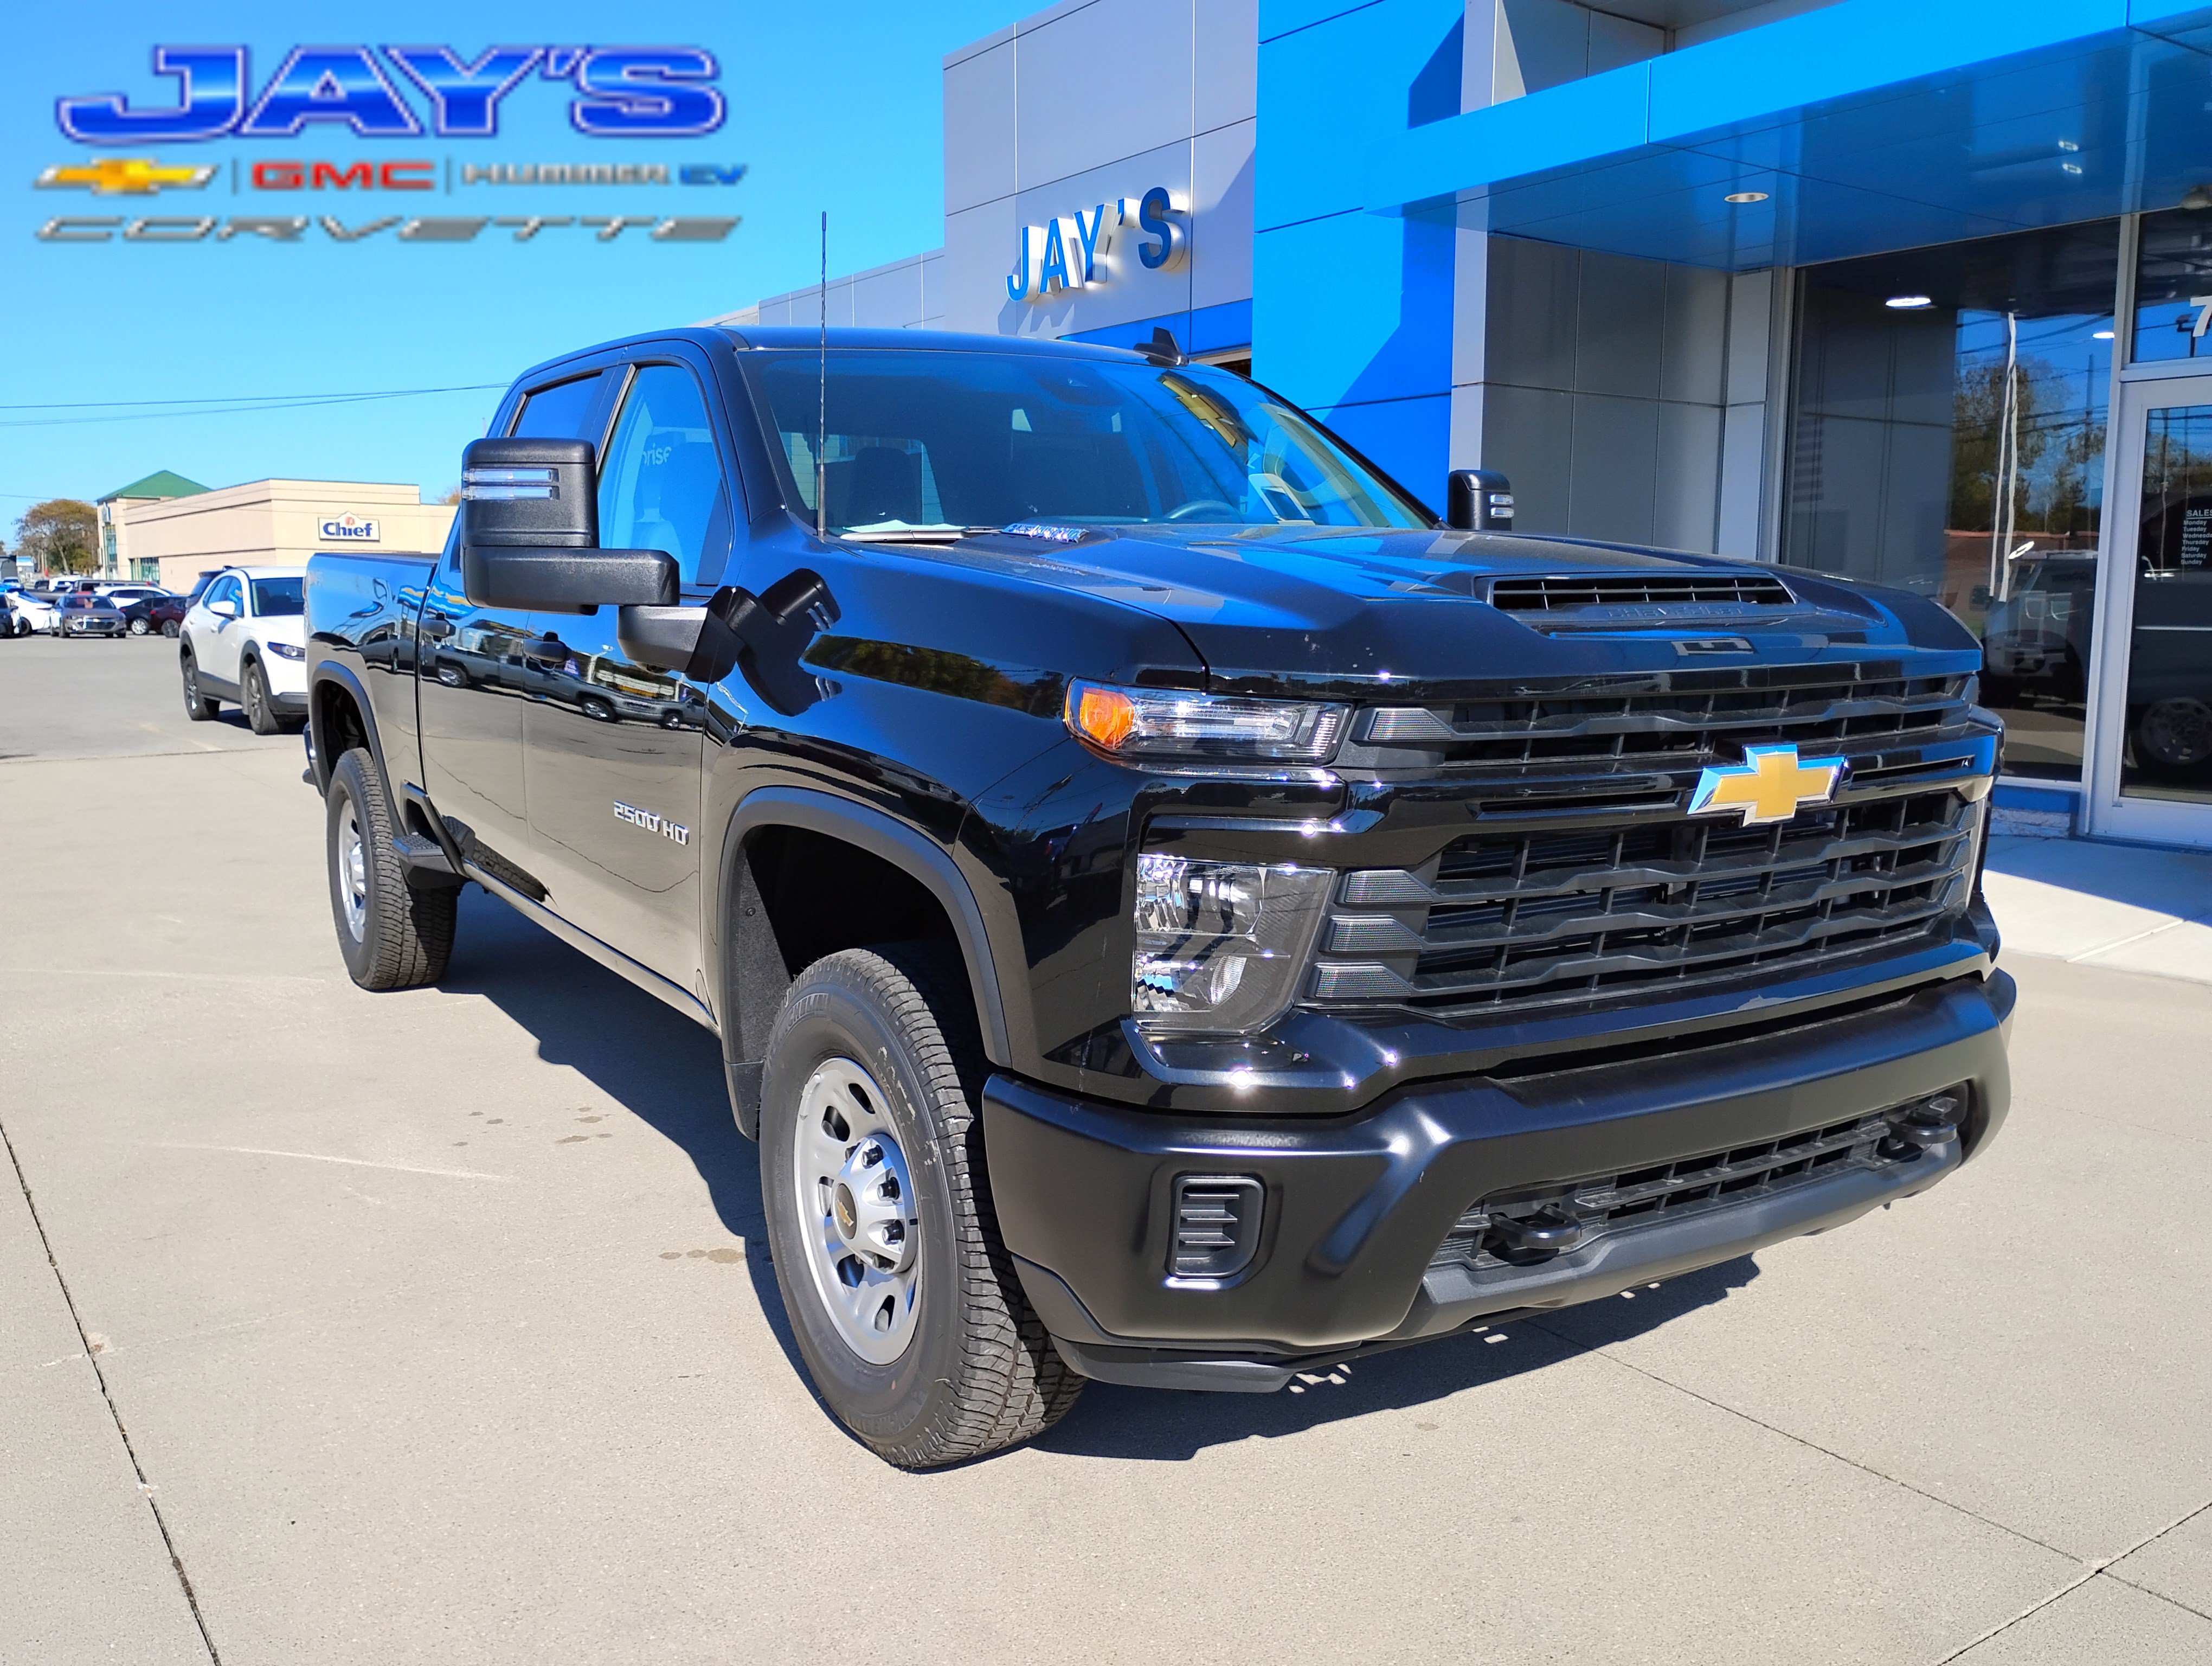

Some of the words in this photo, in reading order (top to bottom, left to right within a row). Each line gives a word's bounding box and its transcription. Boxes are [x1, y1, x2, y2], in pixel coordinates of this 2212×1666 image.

[1006, 187, 1186, 302] JAY'S
[323, 522, 372, 537] Chief
[614, 800, 660, 832] 2500
[663, 819, 689, 845] HD
